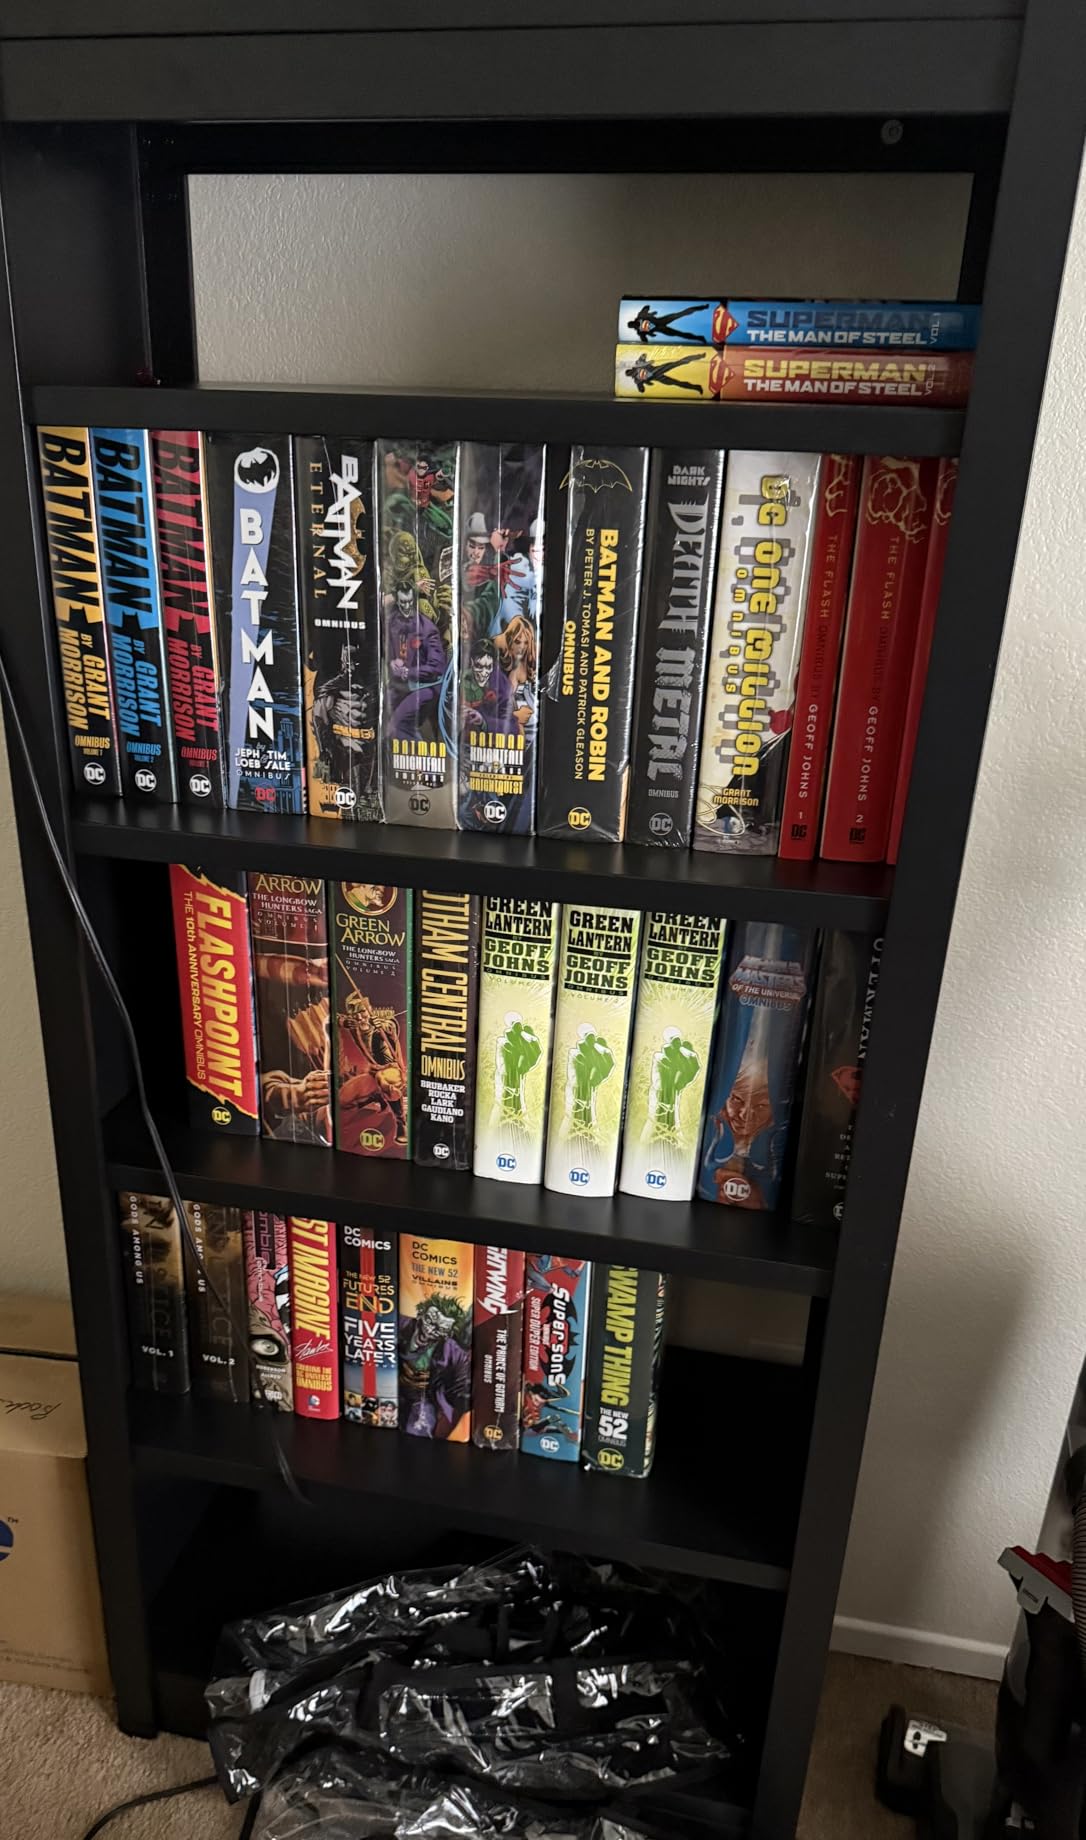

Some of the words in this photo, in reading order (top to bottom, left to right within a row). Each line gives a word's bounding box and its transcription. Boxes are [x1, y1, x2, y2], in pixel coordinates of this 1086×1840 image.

[747, 310, 931, 329] SUPERMAN
[746, 329, 789, 343] THE
[788, 330, 832, 344] MAN
[833, 331, 862, 345] OF
[862, 331, 928, 345] STEEL
[743, 359, 929, 382] SUPERMAN
[743, 379, 783, 392] THE
[784, 380, 828, 394] MAN
[829, 380, 858, 395] OF
[858, 381, 923, 396] STEEL
[667, 475, 711, 486] NIGHTS
[672, 465, 706, 476] DARK
[42, 431, 100, 607] BATMAN
[94, 435, 153, 613] BATMAN
[152, 437, 210, 617] BATMAN
[310, 462, 328, 599] ETERNAL
[320, 454, 363, 610] BATMAN
[586, 528, 595, 545] BY
[824, 535, 838, 564] THE
[888, 536, 900, 565] THE
[583, 548, 594, 587] PETER
[658, 493, 709, 640] DEATH
[582, 590, 592, 600] J.
[595, 529, 619, 641] BATMAN
[819, 568, 835, 618] FLASH
[880, 571, 896, 620] FLASH
[240, 508, 274, 741] BATMAN
[314, 618, 366, 630] OMNIBUS
[580, 603, 592, 648] TOMASI
[132, 639, 146, 655] BY
[562, 620, 577, 696] OMNIBUS
[579, 650, 589, 676] AND
[59, 627, 89, 731] MORRISON
[592, 645, 612, 701] AND
[83, 653, 111, 721] GRANT
[111, 632, 141, 737] MORRISON
[134, 659, 161, 728] GRANT
[168, 636, 197, 742] MORRISON
[191, 664, 219, 732] GRANT
[576, 678, 588, 726] PATRICK
[647, 646, 696, 782] METAL
[805, 703, 819, 750] GEOFF
[863, 705, 878, 753] GEOFF
[74, 734, 111, 750] OMNIBUS
[126, 740, 162, 756] OMNIBUS
[392, 738, 447, 758] BATMAN
[470, 731, 525, 750] BATMAN
[588, 706, 609, 781] ROBIN
[181, 746, 218, 761] OMNIBUS
[235, 748, 260, 759] JEPH
[267, 750, 287, 761] TIM
[393, 754, 446, 773] KNIGHTFALL
[470, 746, 524, 766] KNIGHTFALL
[574, 727, 585, 780] GLEASON
[235, 757, 261, 769] LOEB
[264, 760, 291, 771] SALE
[236, 769, 291, 780] OMNIBUS
[798, 756, 812, 798] JOHNS
[857, 759, 872, 802] JOHNS
[190, 776, 211, 795] DC
[470, 777, 524, 796] KNIGHTQUEST
[648, 788, 679, 799] OMNIBUS
[722, 787, 752, 799] GRANT
[334, 789, 356, 807] DC
[409, 796, 430, 813] DC
[713, 795, 760, 807] MORRISON
[256, 874, 322, 895] ARROW
[184, 891, 194, 918] THE
[252, 893, 271, 902] THE
[270, 894, 317, 907] LONGBOW
[260, 901, 302, 913] HUNTERS
[487, 896, 552, 918] GREEN
[184, 917, 197, 942] 10th
[335, 913, 390, 933] GREEN
[421, 890, 470, 964] OTHAM
[485, 912, 552, 937] LANTERN
[569, 910, 634, 934] GREEN
[651, 912, 721, 931] GREEN
[340, 927, 406, 947] ARROW
[568, 928, 632, 953] LANTERN
[649, 922, 721, 948] LANTERN
[342, 944, 356, 953] THE
[357, 947, 397, 957] LONGBOW
[349, 952, 384, 962] HUNTERS
[485, 938, 551, 959] GEOFF
[646, 947, 719, 968] GEOFF
[484, 953, 550, 973] JOHNS
[566, 954, 631, 975] GEOFF
[644, 960, 715, 981] JOHNS
[187, 943, 203, 1027] ANNIVERSARY
[564, 969, 629, 989] JOHNS
[731, 983, 743, 991] OF
[744, 985, 761, 994] THE
[196, 892, 243, 1097] FLASHPOINT
[421, 967, 469, 1053] CENTRAL
[194, 1029, 206, 1080] OMNIBUS
[420, 1054, 466, 1081] OMNIBUS
[420, 1079, 466, 1094] BRUBAKER
[428, 1089, 457, 1101] RUCKA
[420, 1104, 464, 1117] GAUDIANO
[430, 1097, 454, 1108] LARK
[212, 1108, 231, 1124] DC
[430, 1113, 454, 1124] KANO
[360, 1130, 385, 1149] DC
[433, 1144, 450, 1158] DC
[496, 1154, 517, 1170] DC
[569, 1169, 590, 1184] DC
[645, 1171, 667, 1187] DC
[724, 1180, 751, 1199] DC
[129, 1195, 139, 1225] GODS
[291, 1216, 329, 1247] ST
[343, 1225, 361, 1237] DC
[132, 1229, 142, 1266] AMONG
[193, 1203, 202, 1233] GODS
[198, 1279, 207, 1292] US
[343, 1236, 392, 1251] COMICS
[411, 1241, 429, 1252] DC
[411, 1251, 458, 1265] COMICS
[135, 1271, 144, 1285] US
[346, 1270, 358, 1279] THE
[378, 1274, 391, 1283] 52
[411, 1262, 426, 1273] THE
[427, 1265, 446, 1277] NEW
[447, 1268, 459, 1279] 52
[411, 1274, 458, 1286] VILLAINS
[292, 1241, 331, 1341] IMAGINE
[343, 1278, 395, 1296] FUTURES
[345, 1293, 394, 1315] END
[529, 1296, 541, 1316] SUPER
[605, 1266, 639, 1343] WAMP
[343, 1315, 395, 1339] FIVE
[496, 1329, 508, 1343] THE
[529, 1316, 541, 1344] DUPER
[141, 1345, 166, 1356] VOL.
[344, 1332, 395, 1351] YEARS
[202, 1353, 227, 1365] VOL.
[344, 1344, 397, 1363] LATER
[495, 1344, 507, 1370] PRINCE
[528, 1345, 540, 1371] EDITION
[483, 1354, 493, 1384] OMNIBUS
[495, 1370, 506, 1382] OF
[601, 1345, 633, 1407] THING
[494, 1383, 506, 1413] GOTHAM
[599, 1406, 612, 1416] THE
[612, 1410, 630, 1420] NEW
[598, 1414, 629, 1440] 52
[541, 1437, 559, 1451] DC
